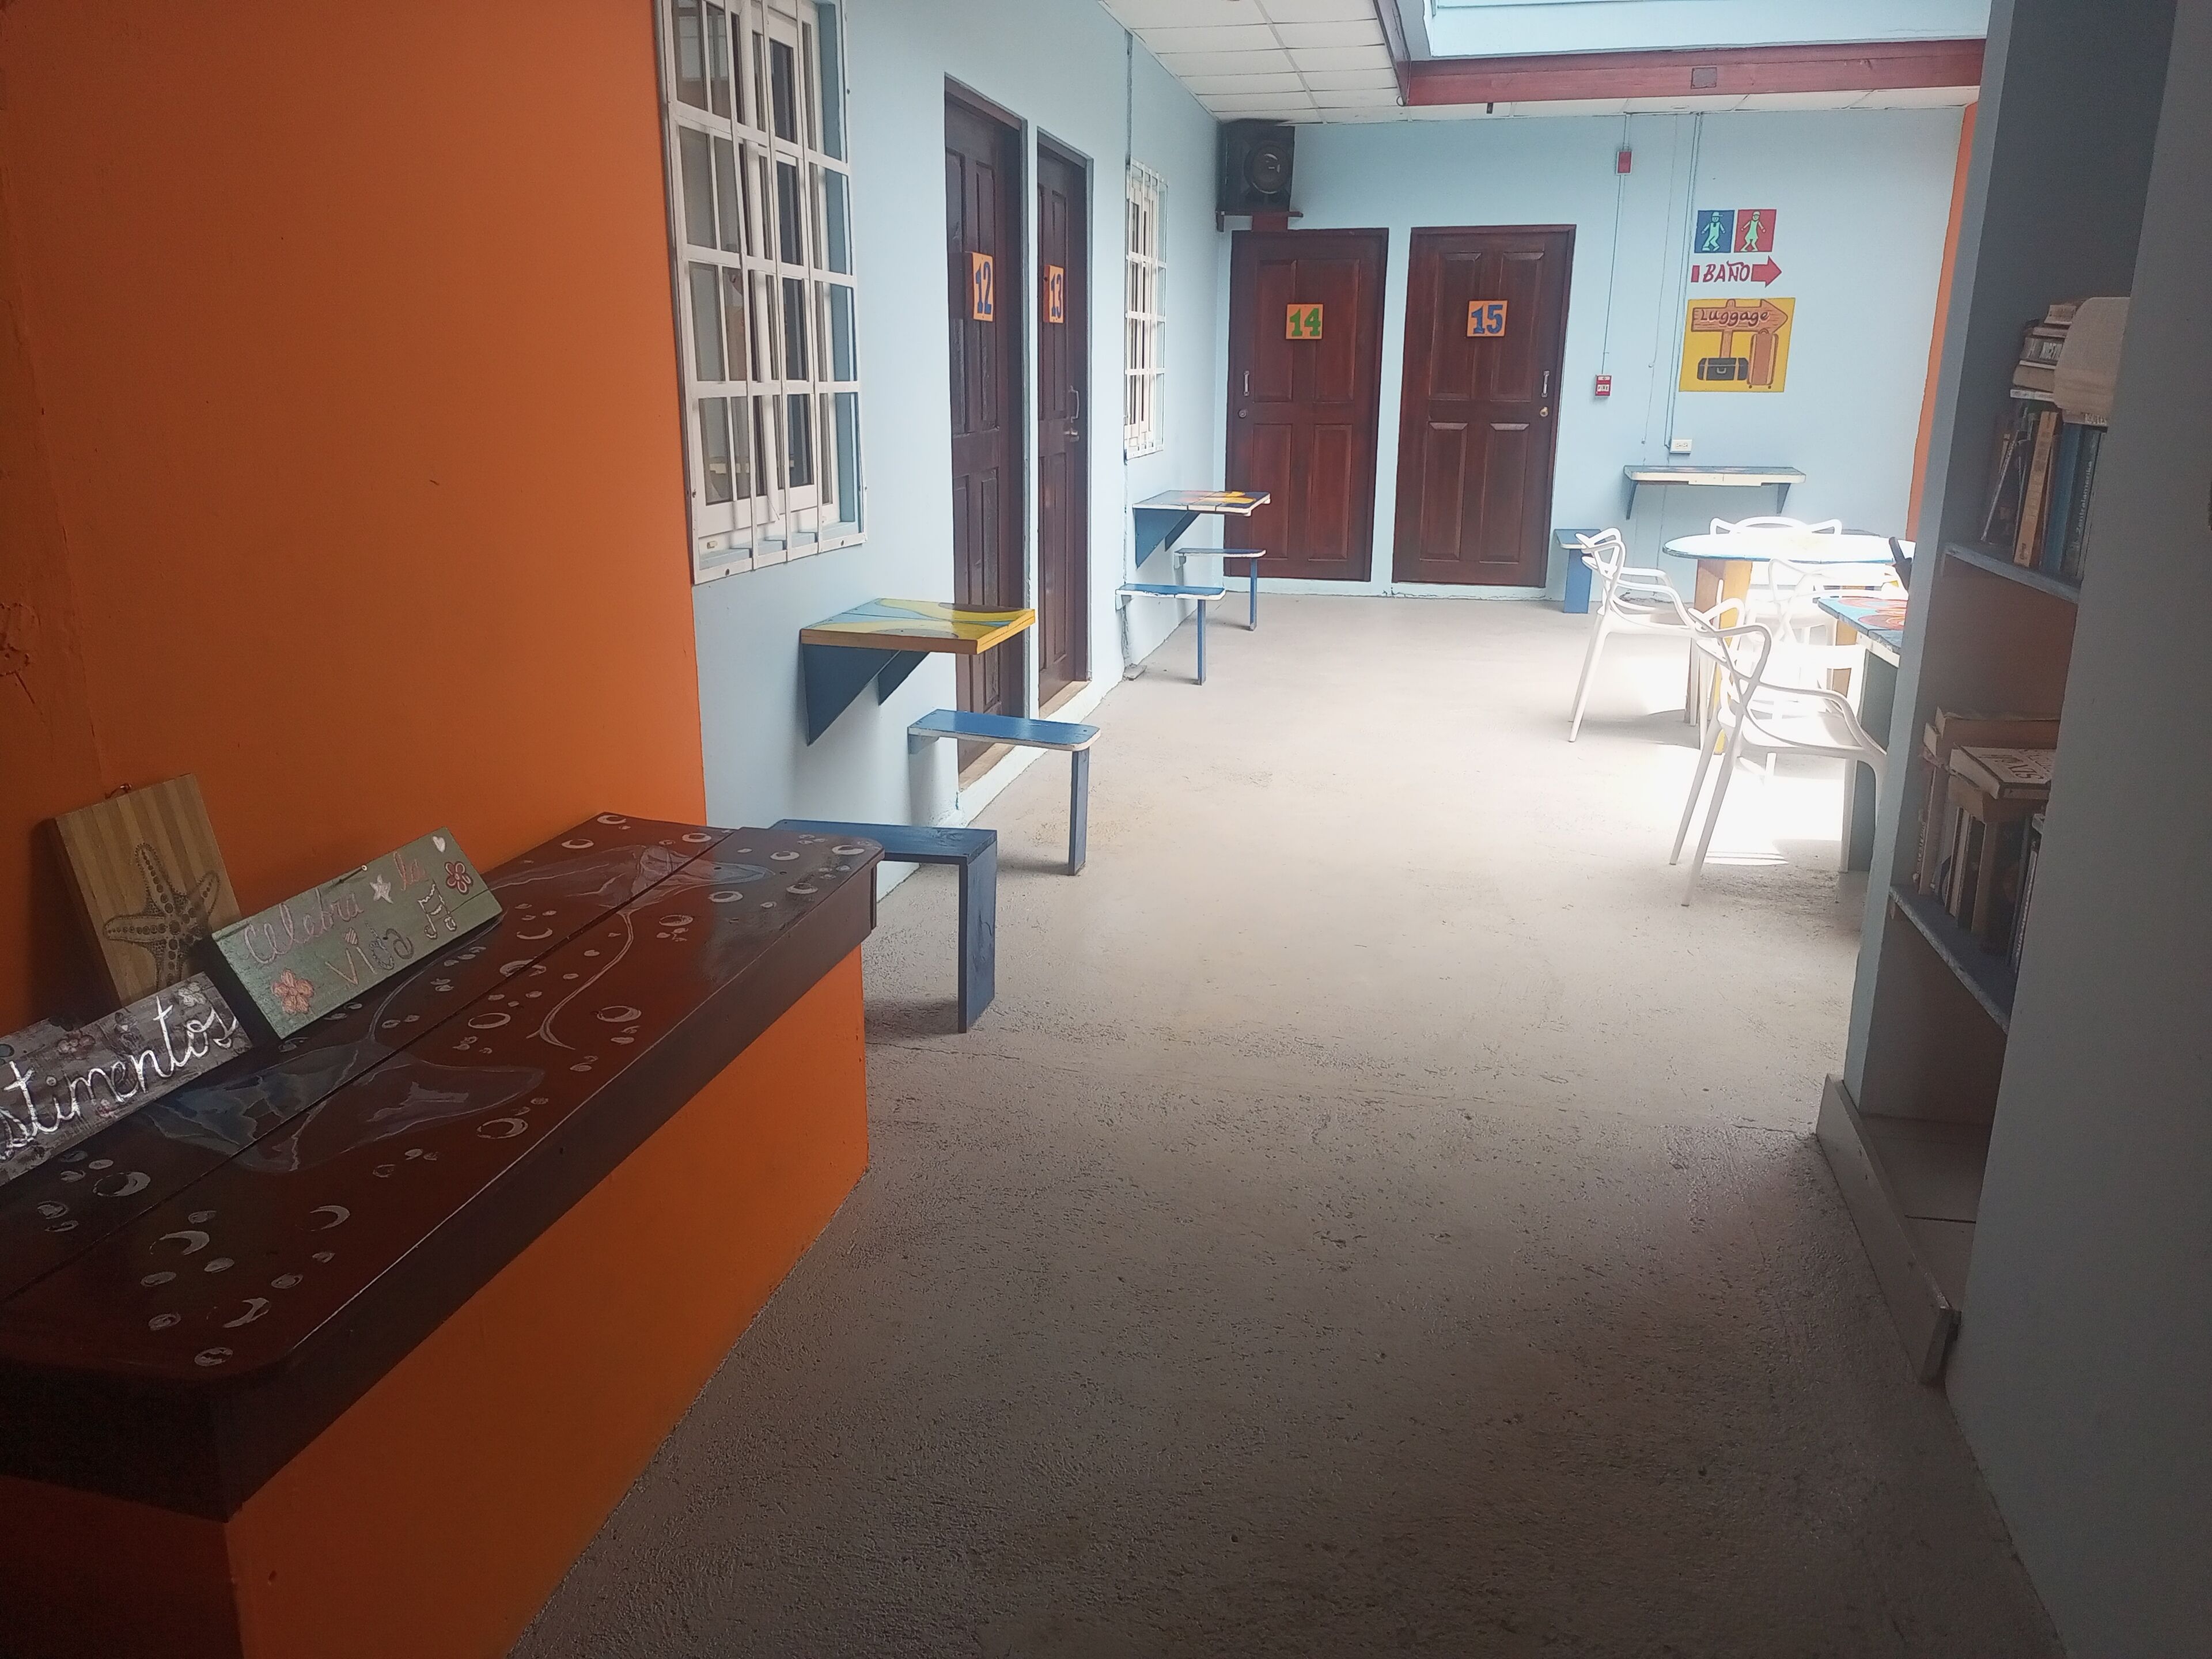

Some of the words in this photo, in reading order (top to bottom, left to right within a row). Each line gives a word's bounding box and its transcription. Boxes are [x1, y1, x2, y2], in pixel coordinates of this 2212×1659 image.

[1702, 260, 1751, 283] BAÑO
[975, 261, 992, 315] 12
[1051, 273, 1062, 319] 13
[1289, 308, 1321, 337] 14
[1471, 304, 1503, 334] 15
[1700, 308, 1770, 327] Luggage
[244, 889, 365, 964] Celebra
[393, 851, 429, 892] la
